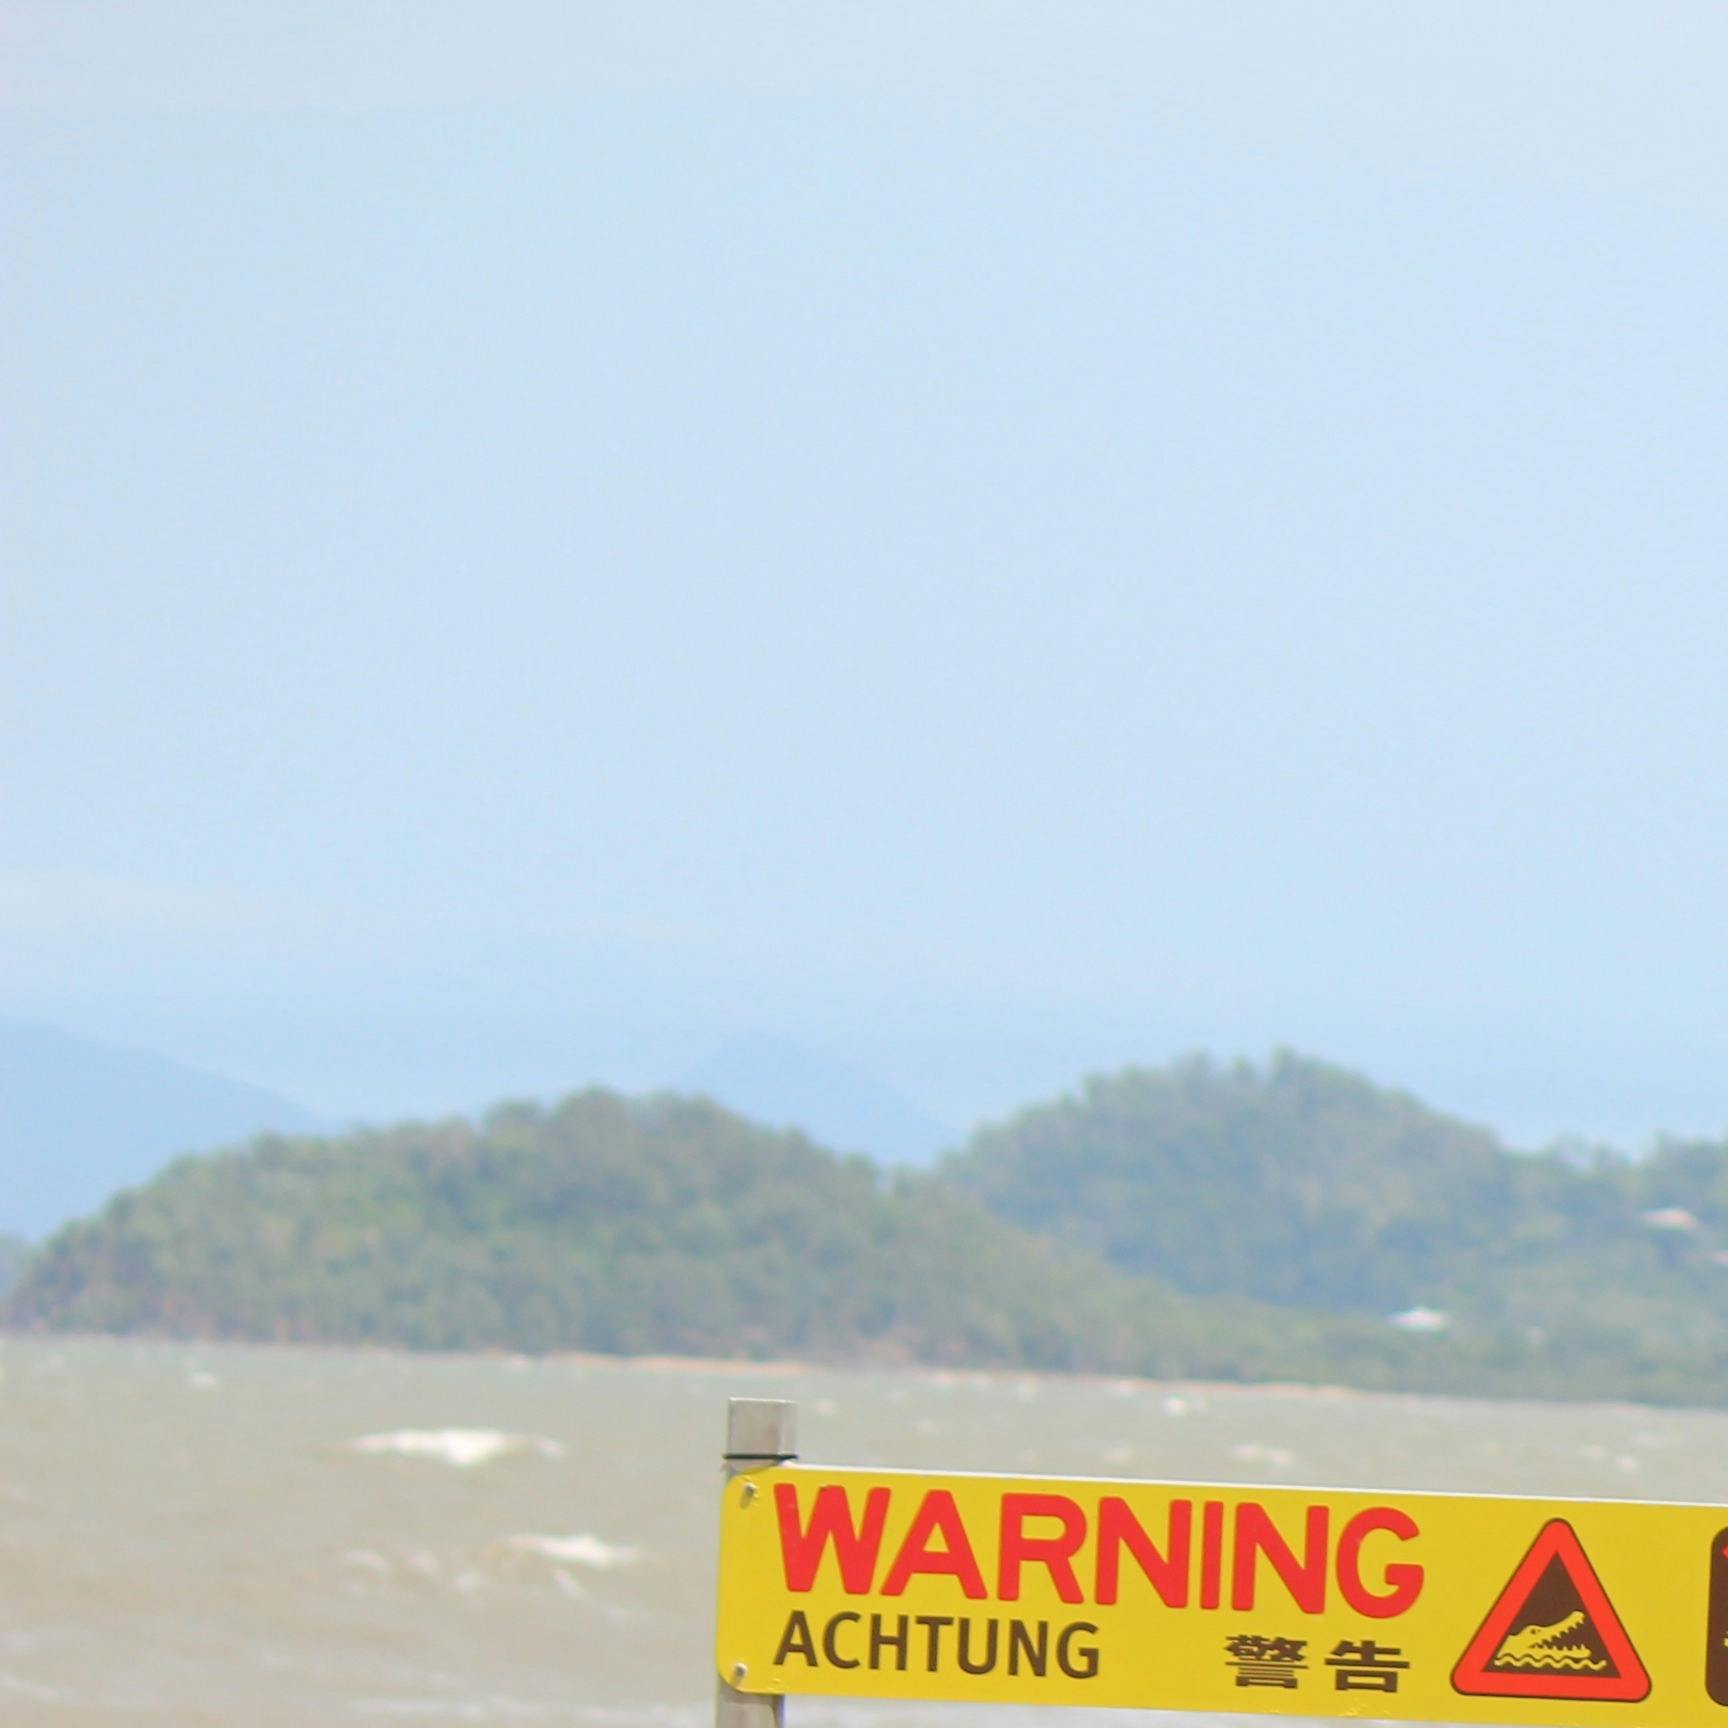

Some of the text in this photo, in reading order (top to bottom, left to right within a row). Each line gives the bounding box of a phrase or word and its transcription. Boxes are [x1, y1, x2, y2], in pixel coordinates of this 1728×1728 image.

[774, 1483, 1424, 1619] WARNING
[773, 1610, 1099, 1678] ACHTUNG
[1223, 1634, 1411, 1693] 警告
